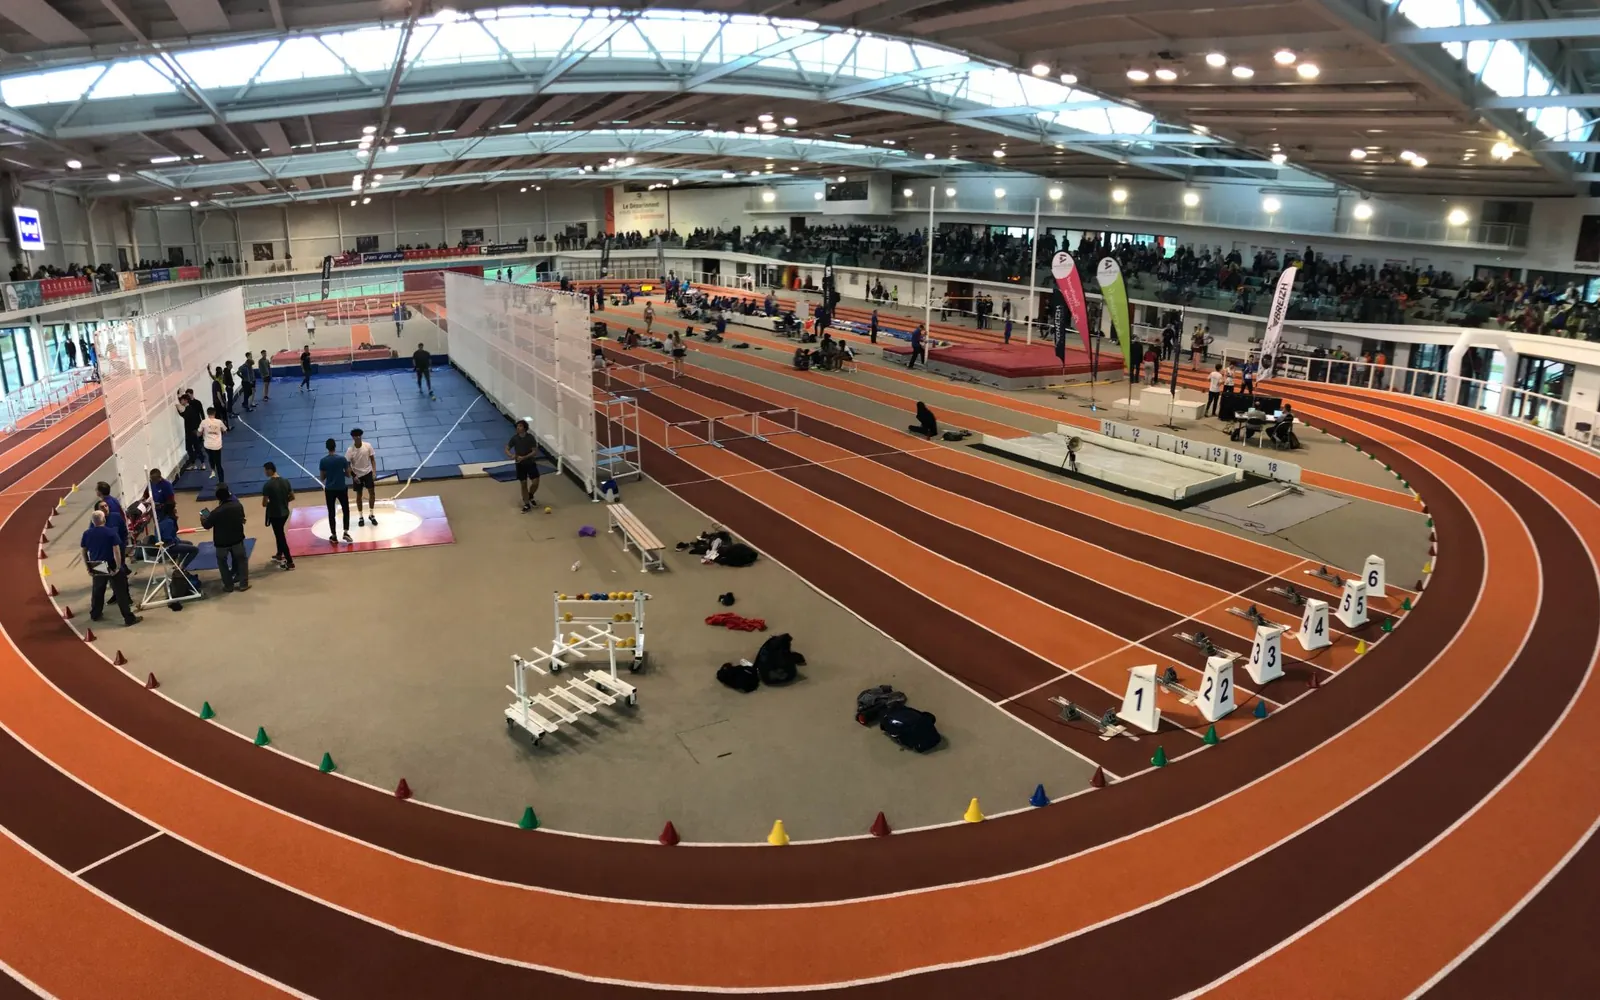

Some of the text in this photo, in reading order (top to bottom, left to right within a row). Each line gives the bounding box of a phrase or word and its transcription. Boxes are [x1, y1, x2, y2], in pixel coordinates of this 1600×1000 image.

[1273, 282, 1289, 321] BREIZH
[1104, 421, 1112, 431] 11
[1131, 428, 1140, 438] 12
[1180, 440, 1189, 450] 14
[1213, 447, 1221, 457] 15
[1233, 453, 1242, 463] 19
[1268, 461, 1278, 473] 18
[1368, 570, 1379, 588] 6
[1343, 593, 1352, 612] 5
[1356, 596, 1364, 615] 5
[1303, 614, 1310, 634] 4
[1314, 616, 1324, 637] 4
[1253, 642, 1261, 665] 3
[1267, 645, 1276, 668] 3
[1203, 676, 1213, 702] 2
[1219, 677, 1229, 704] 2
[1134, 687, 1144, 712] 1
